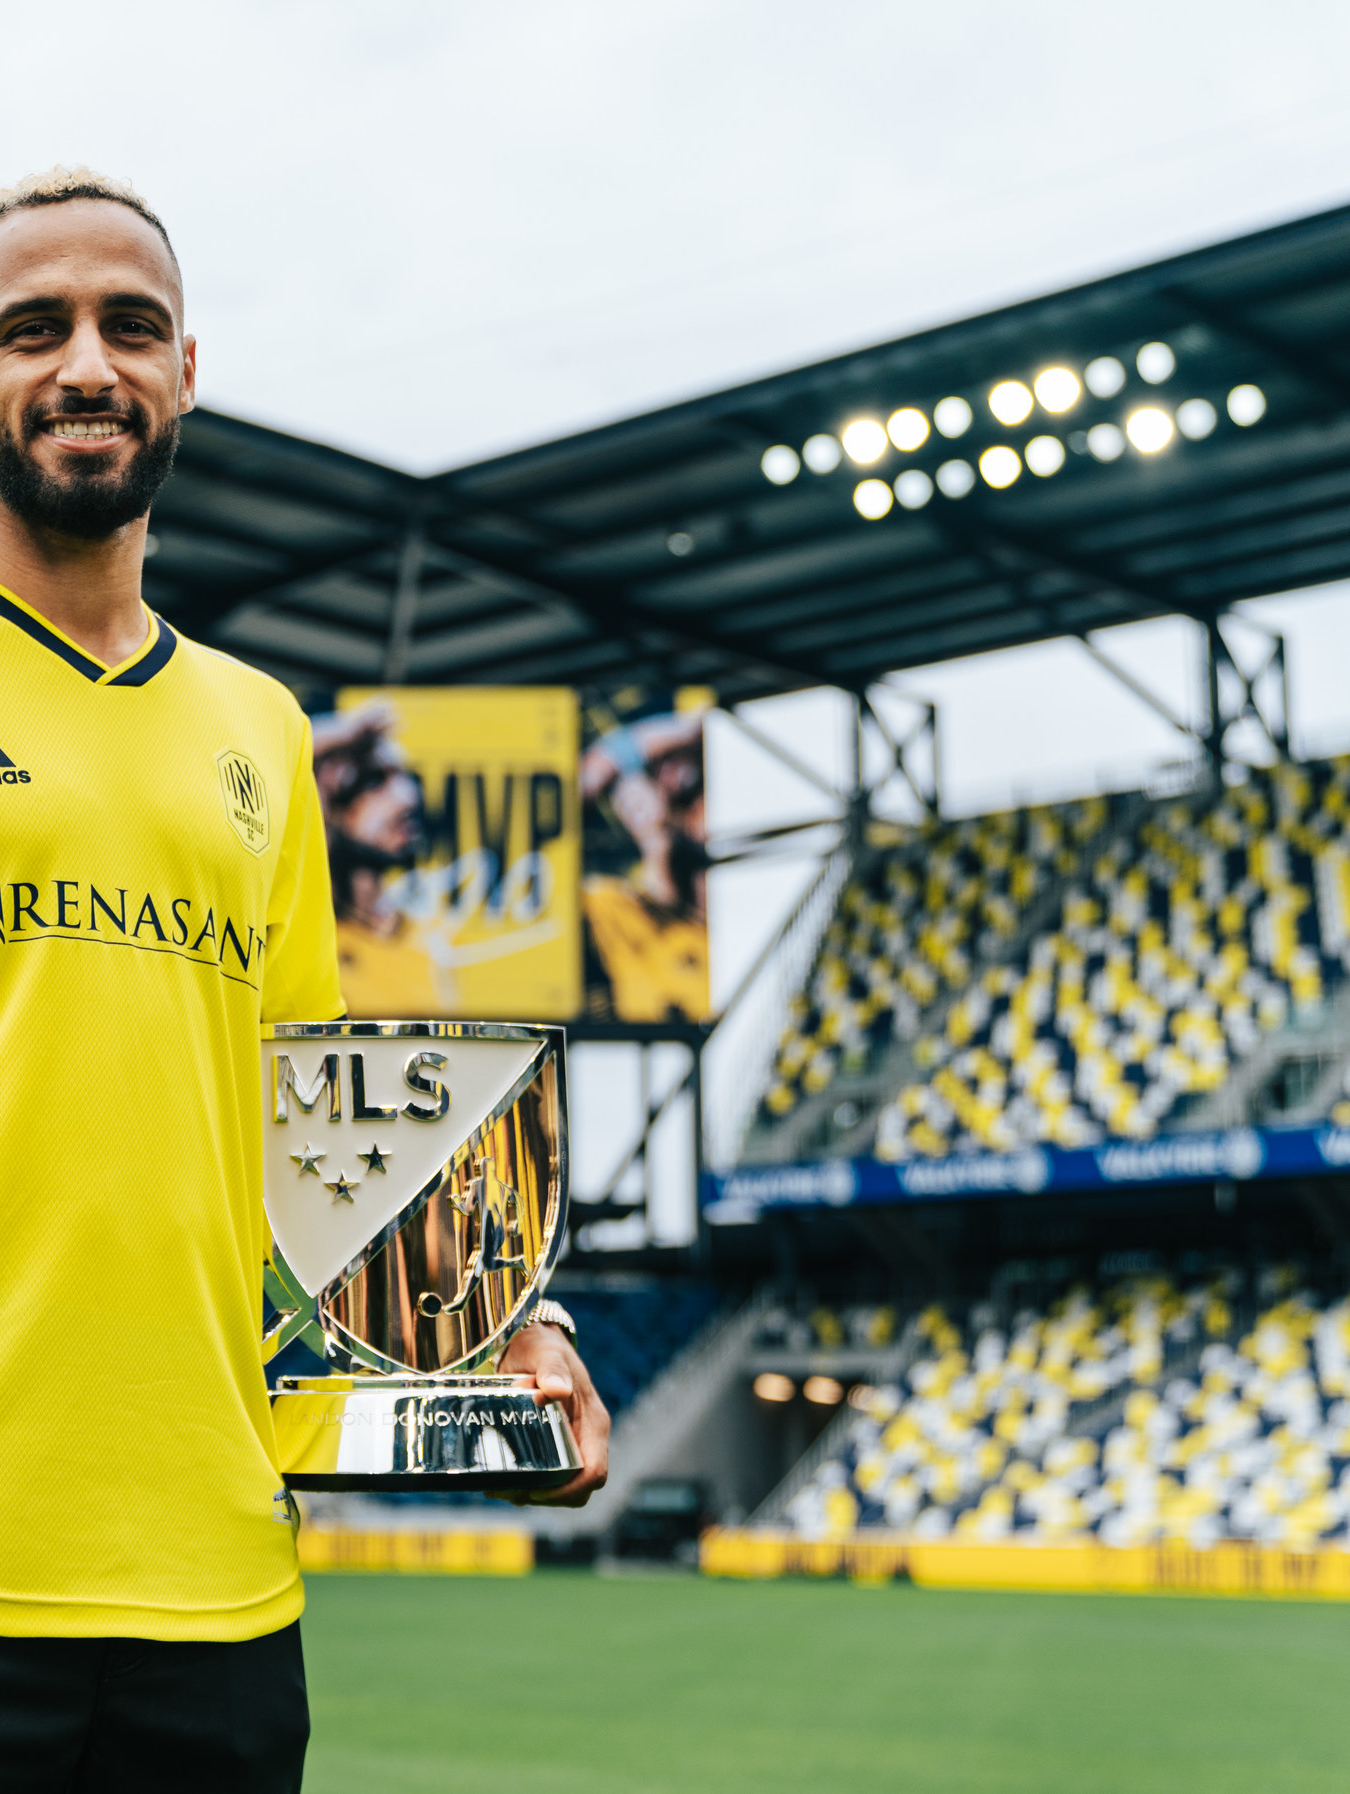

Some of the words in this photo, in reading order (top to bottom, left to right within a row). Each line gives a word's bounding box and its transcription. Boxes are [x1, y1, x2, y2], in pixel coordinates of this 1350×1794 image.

[233, 808, 264, 835] NASHVILLE
[7, 880, 266, 973] RENASANT
[274, 1052, 450, 1122] MLS
[382, 1410, 495, 1427] DONOVAN
[500, 1410, 538, 1425] MVP
